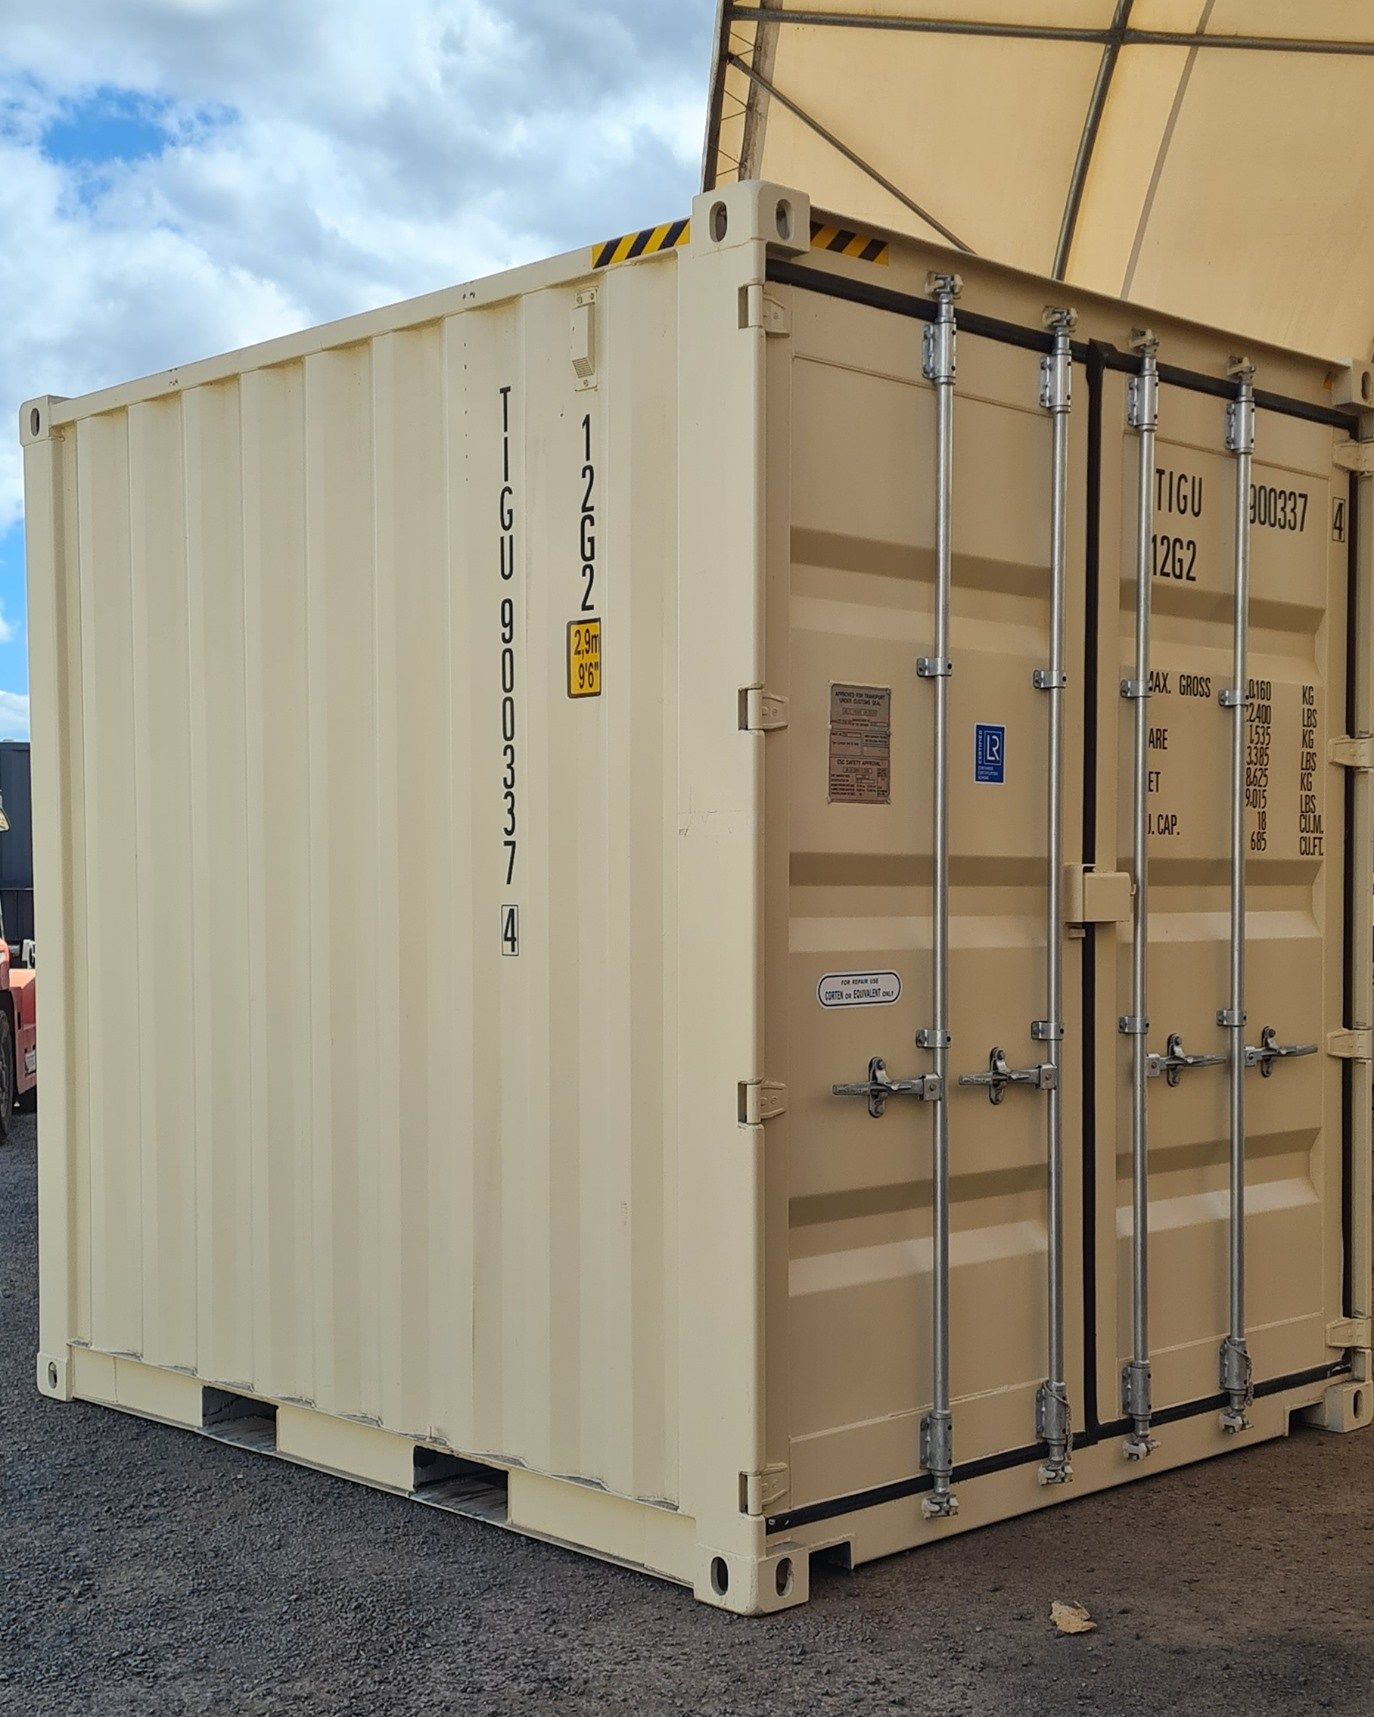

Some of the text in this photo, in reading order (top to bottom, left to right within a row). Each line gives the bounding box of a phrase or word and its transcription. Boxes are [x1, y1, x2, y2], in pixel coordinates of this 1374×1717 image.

[580, 413, 595, 612] 12G2
[1156, 468, 1343, 540] TIGU 900337 4
[1152, 534, 1197, 582] 12G2
[499, 386, 517, 953] TIGU 900337 4
[1179, 674, 1211, 698] GROSS
[1302, 685, 1314, 706] KG
[1302, 708, 1317, 728] LBS
[1149, 727, 1168, 750] ARE
[1302, 729, 1314, 749] KG
[1301, 751, 1317, 771] LBS
[1148, 771, 1161, 793] ET
[1300, 772, 1312, 791] KG
[1300, 794, 1316, 814] LBS
[1257, 811, 1267, 831] 18
[1250, 831, 1267, 851] 685
[824, 990, 844, 1001] CORTEN
[853, 988, 881, 1000] EQUIVALENT
